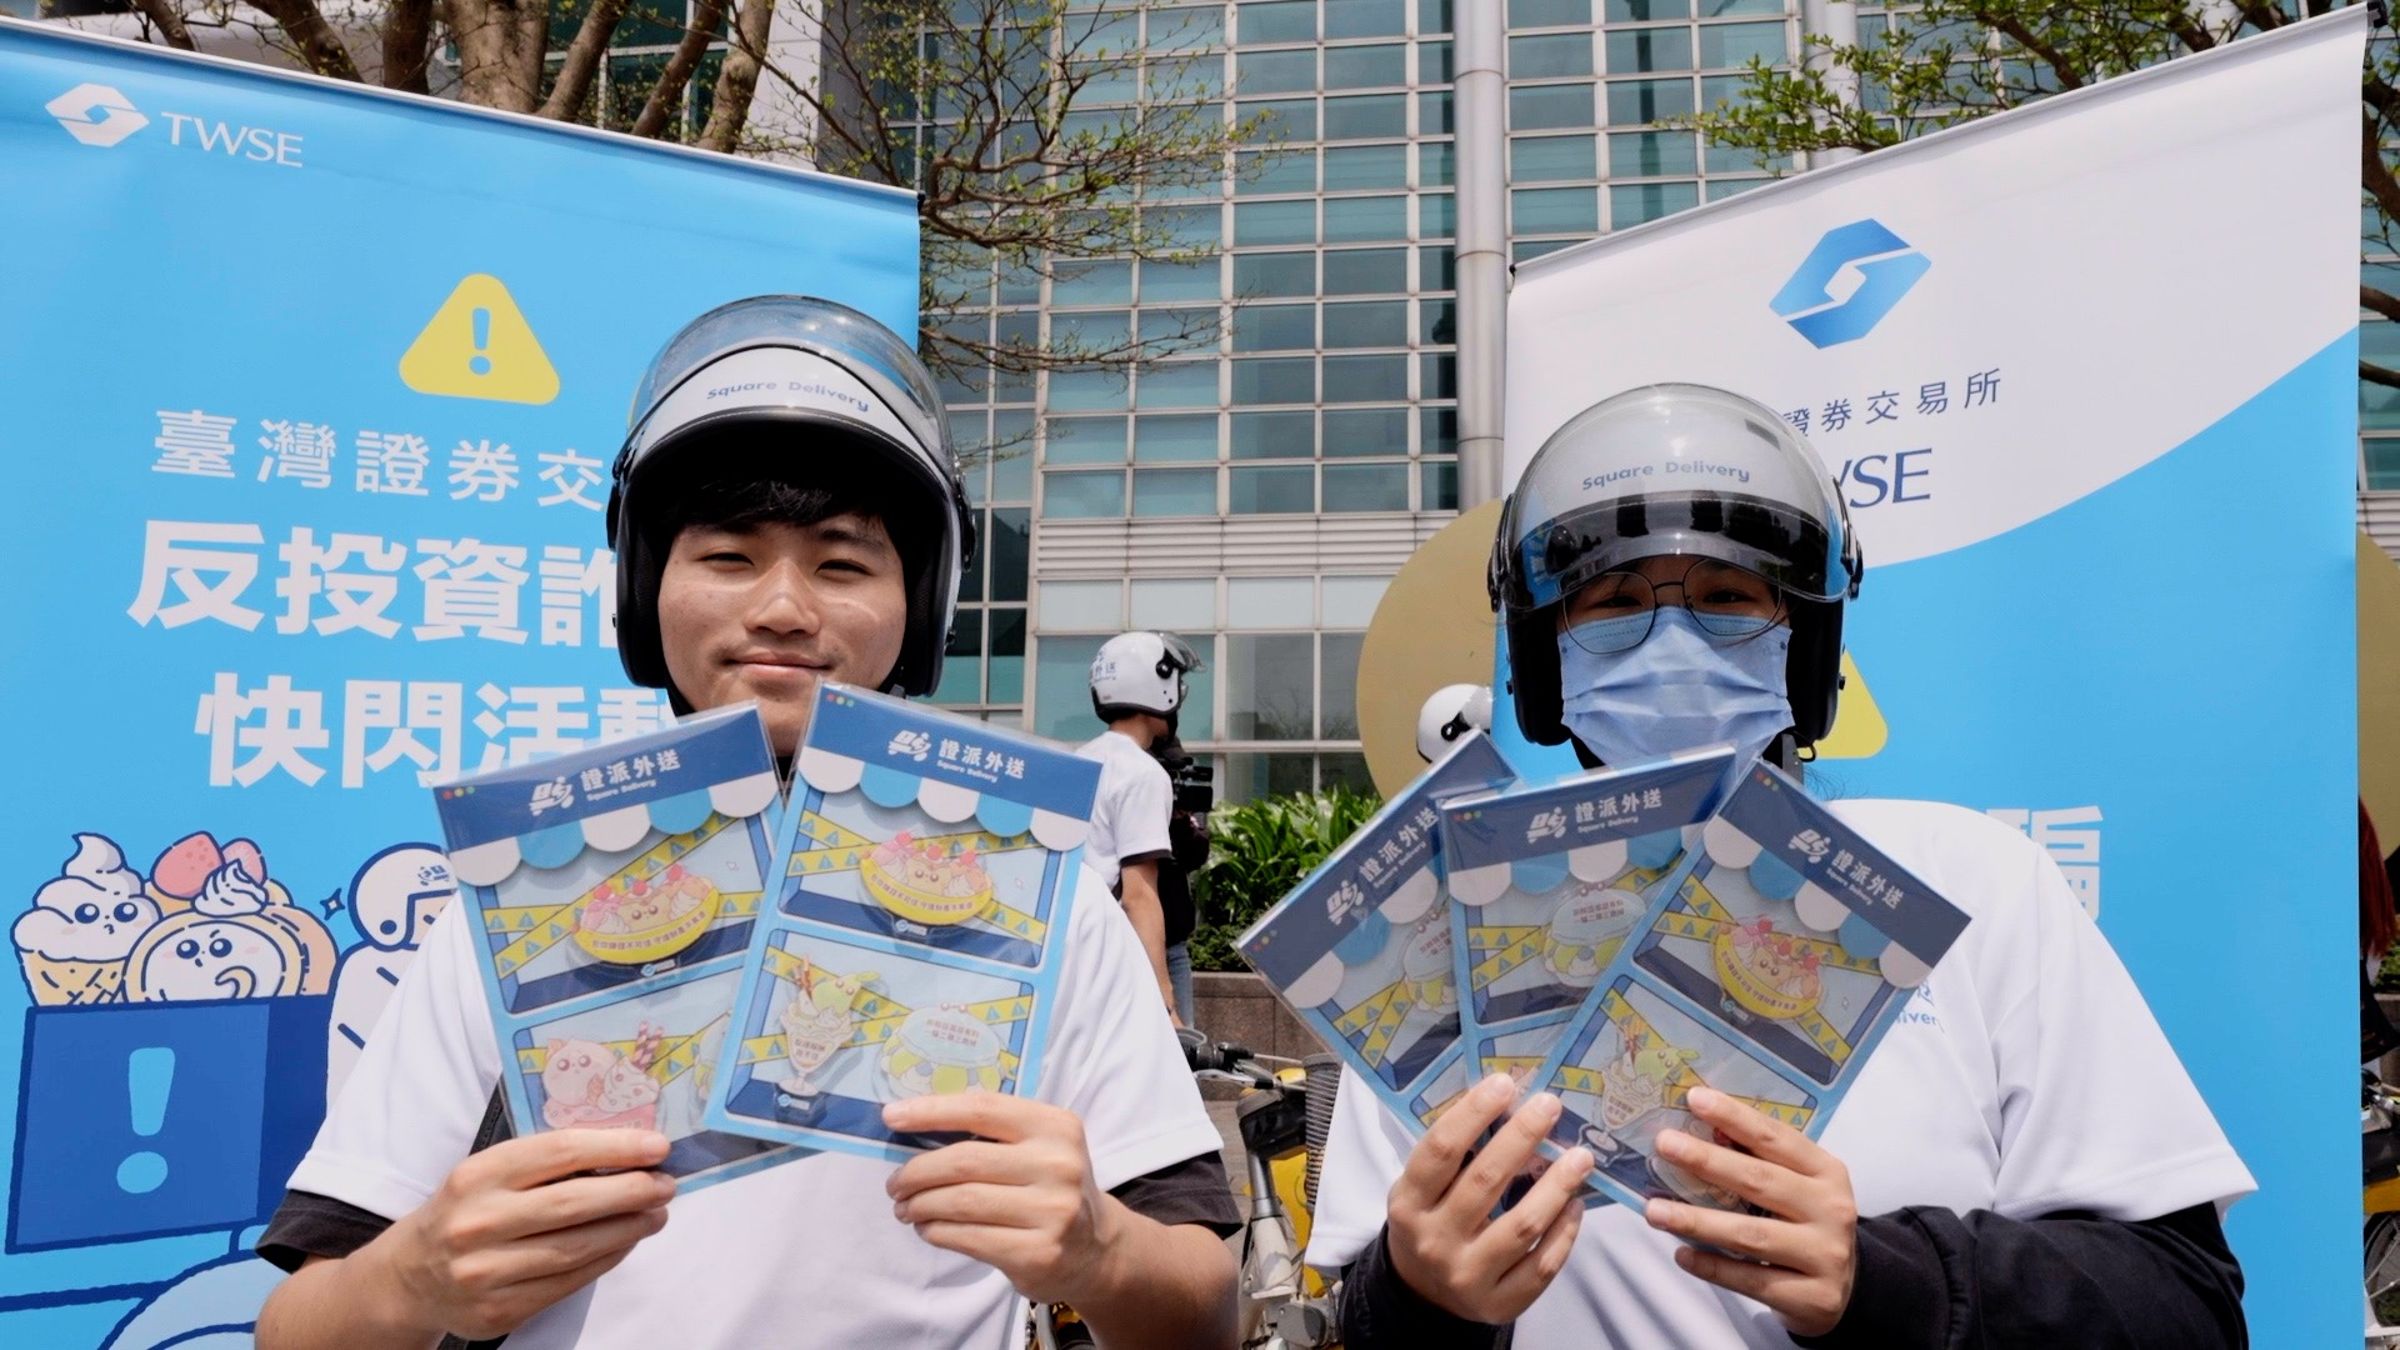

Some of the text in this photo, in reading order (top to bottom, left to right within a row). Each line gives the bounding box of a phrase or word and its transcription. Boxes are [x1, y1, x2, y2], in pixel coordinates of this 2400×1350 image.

[162, 111, 303, 167] TWSE
[788, 381, 870, 413] Delivery
[151, 409, 604, 512] 臺灣證券交
[1665, 460, 1751, 483] Delivery
[1838, 448, 1933, 509] SE
[580, 748, 681, 792] 證派外送
[939, 738, 1025, 780] 證派外送
[1575, 788, 1663, 824] 證派外送
[1360, 807, 1440, 883] 證派外送
[1832, 849, 1905, 910] 證派外送
